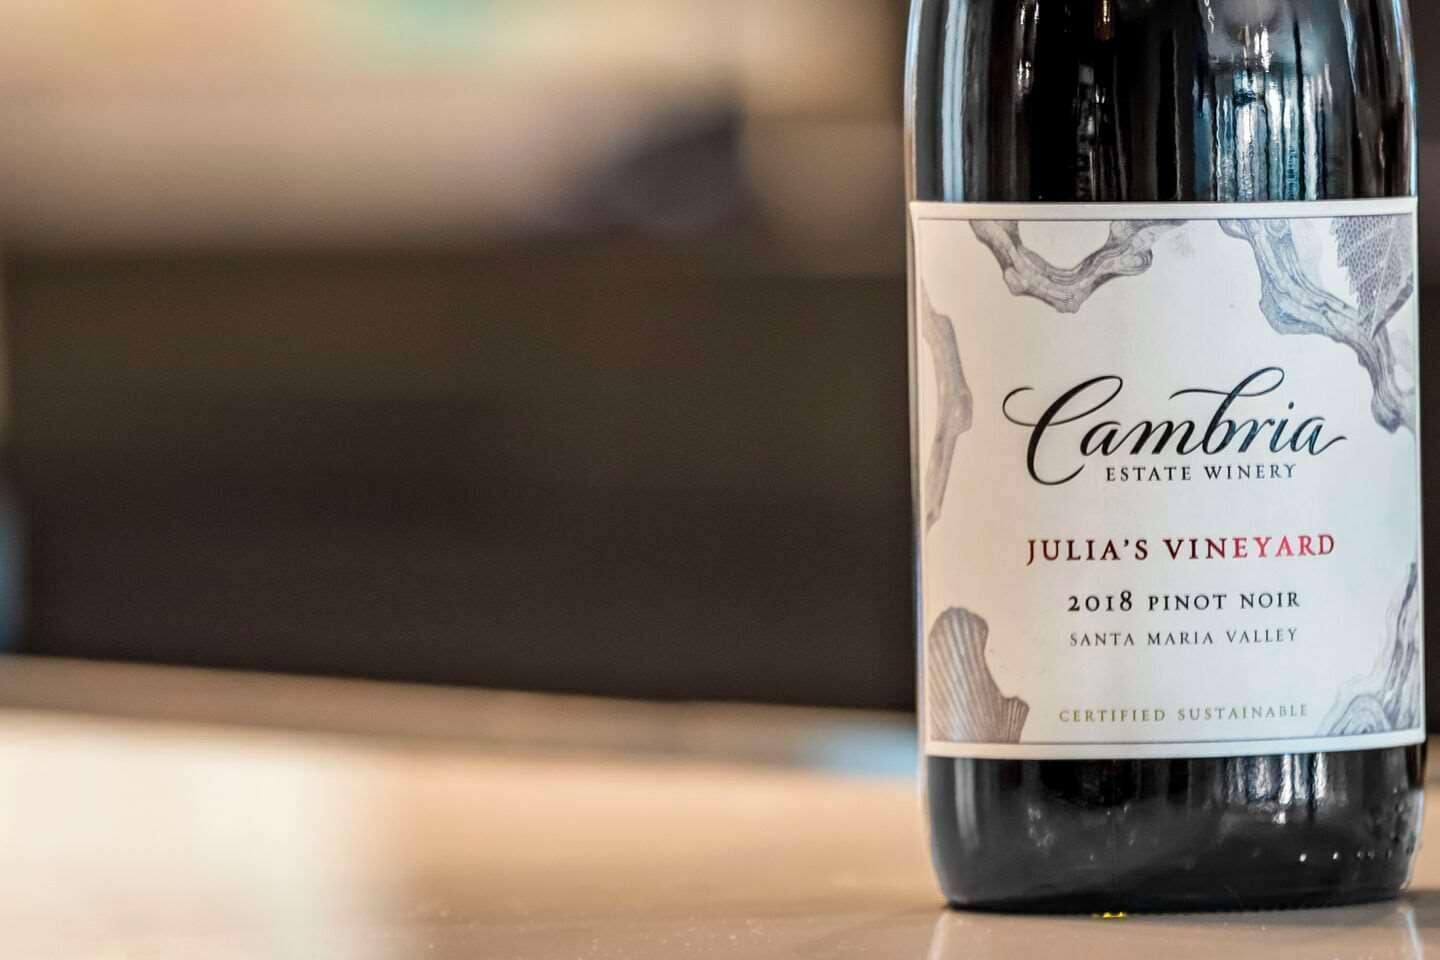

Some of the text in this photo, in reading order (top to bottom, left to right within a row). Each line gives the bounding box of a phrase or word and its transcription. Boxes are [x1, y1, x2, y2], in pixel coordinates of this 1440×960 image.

[1002, 366, 1348, 486] Cambria
[1105, 463, 1298, 483] ESTATE WINERY
[1025, 533, 1336, 567] JULIA'S VINEYARD
[1067, 590, 1302, 614] 2018 PINOT NOIR
[1069, 626, 1300, 648] SANTA MARIA VALLEY
[1058, 702, 1310, 723] CERTIFIED SUSTAINABLE
